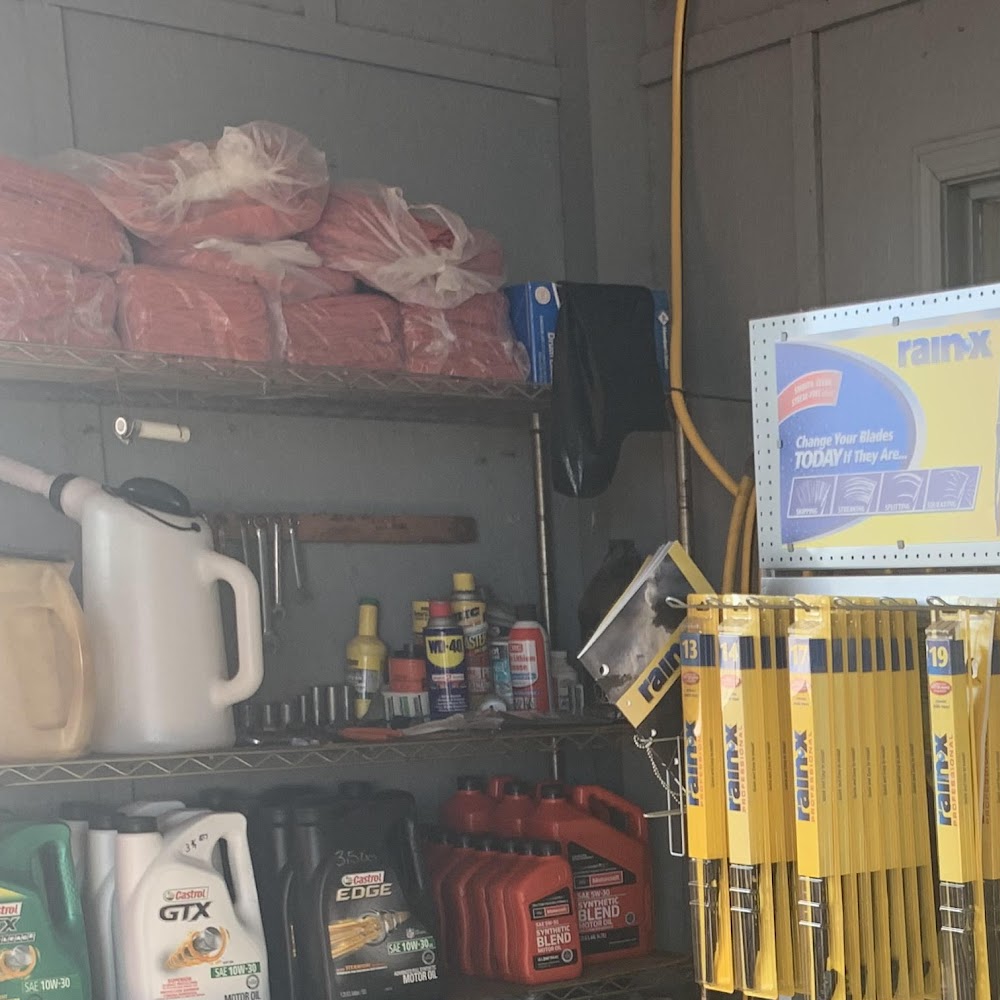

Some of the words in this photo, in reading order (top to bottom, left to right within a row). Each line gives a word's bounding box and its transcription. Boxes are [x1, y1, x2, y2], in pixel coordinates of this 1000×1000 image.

[796, 435, 832, 450] Change
[834, 432, 858, 447] Your
[860, 428, 894, 443] Blades
[794, 448, 844, 471] TODAY
[844, 450, 853, 464] If
[854, 448, 878, 465] They
[880, 448, 907, 461] Are...
[428, 638, 462, 654] WD-40
[682, 639, 698, 659] 13
[720, 642, 738, 662] 14
[791, 644, 808, 667] 17
[929, 646, 948, 668] 19
[738, 725, 748, 813] PROFESSIONAL
[808, 732, 816, 822] PROFESSIONAL
[949, 735, 958, 826] PROFESSIONAL
[353, 872, 382, 885] Castrol
[175, 888, 206, 900] Castrol
[336, 882, 393, 902] EDGE
[577, 891, 590, 900] SAE
[590, 889, 610, 898] 5W-30
[578, 896, 620, 910] SYNTHETIC
[159, 901, 213, 922] GTX
[578, 904, 620, 922] BLEND
[536, 924, 570, 937] SYNTHETIC
[578, 920, 603, 929] MOTOR
[388, 944, 401, 954] SAE
[402, 938, 430, 952] 10W-30
[536, 932, 572, 948] BLEND
[214, 967, 228, 978] SAE
[228, 964, 258, 976] 10W-30
[402, 970, 428, 984] MOTOR
[428, 970, 438, 980] OIL
[24, 980, 39, 993] SAE
[40, 978, 71, 990] 10W-30
[250, 990, 262, 1000] OIL
